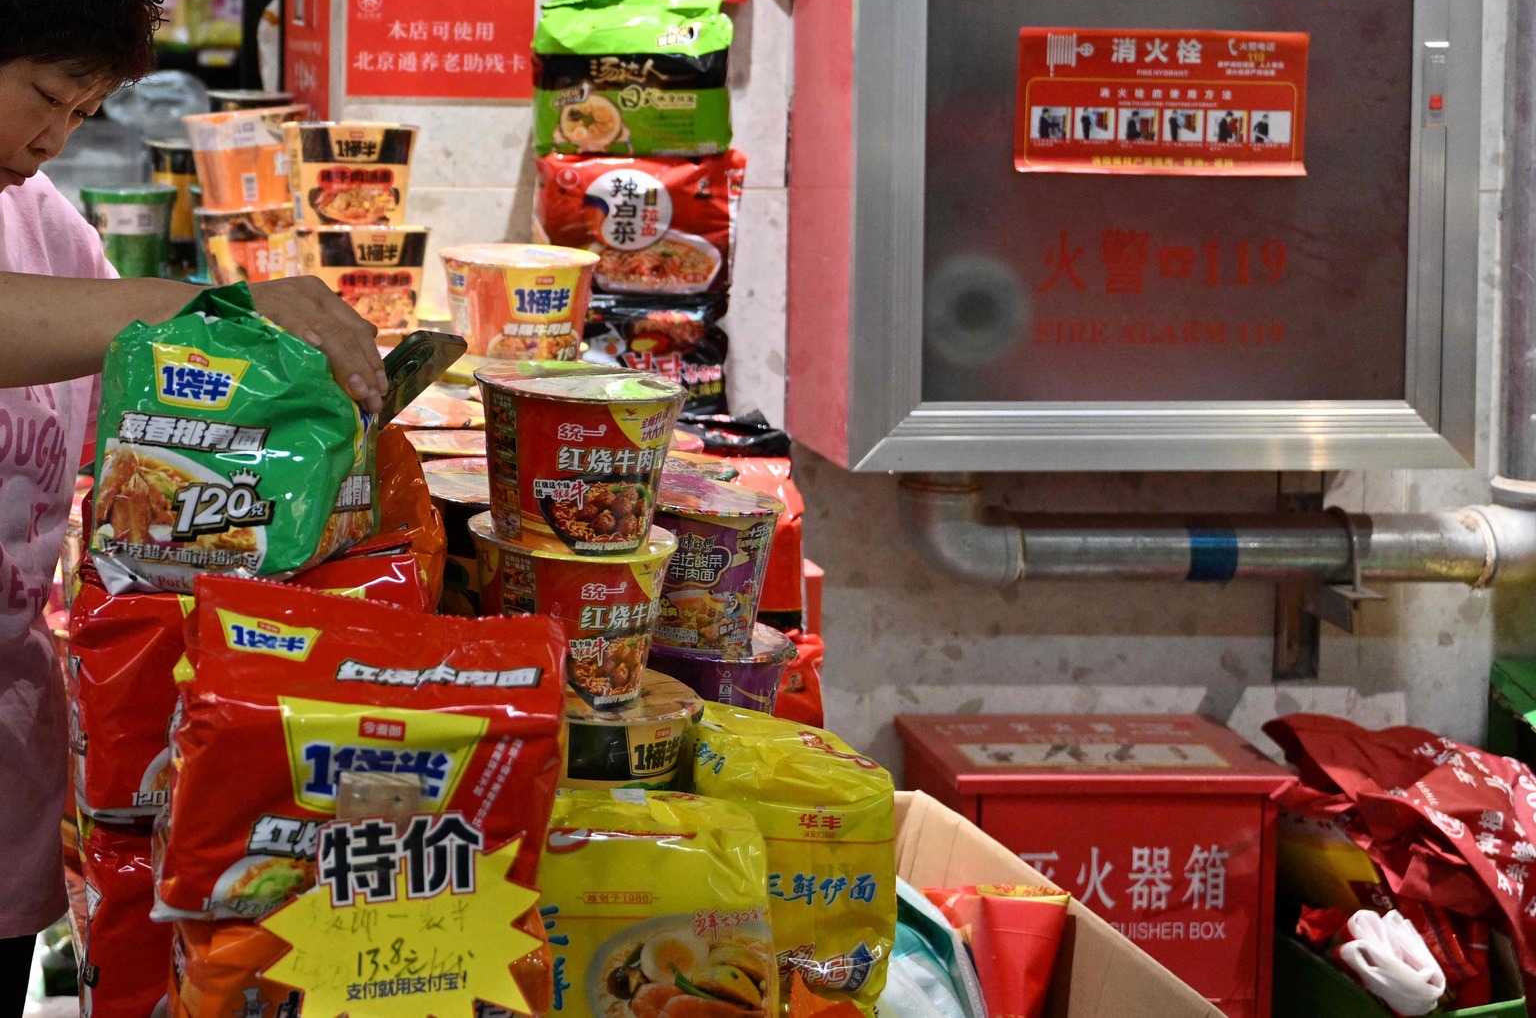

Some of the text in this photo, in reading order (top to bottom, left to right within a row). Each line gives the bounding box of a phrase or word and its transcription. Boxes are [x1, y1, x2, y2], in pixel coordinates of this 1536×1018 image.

[387, 19, 495, 42] 本店可使用
[1111, 38, 1202, 64] 消火栓
[352, 51, 527, 75] 北京通养老助残卡
[1202, 238, 1288, 287] 119
[514, 288, 570, 314] 1桶半
[161, 365, 235, 402] 1袋半
[557, 424, 600, 442] 统一
[670, 567, 715, 582] 牛肉面
[581, 583, 620, 601] 统一
[362, 719, 402, 739] 今麦郎
[798, 813, 843, 830] 华丰
[320, 817, 482, 904] 特价
[1190, 921, 1226, 940] BOX
[346, 971, 468, 1002] 支付就用支付宝！
